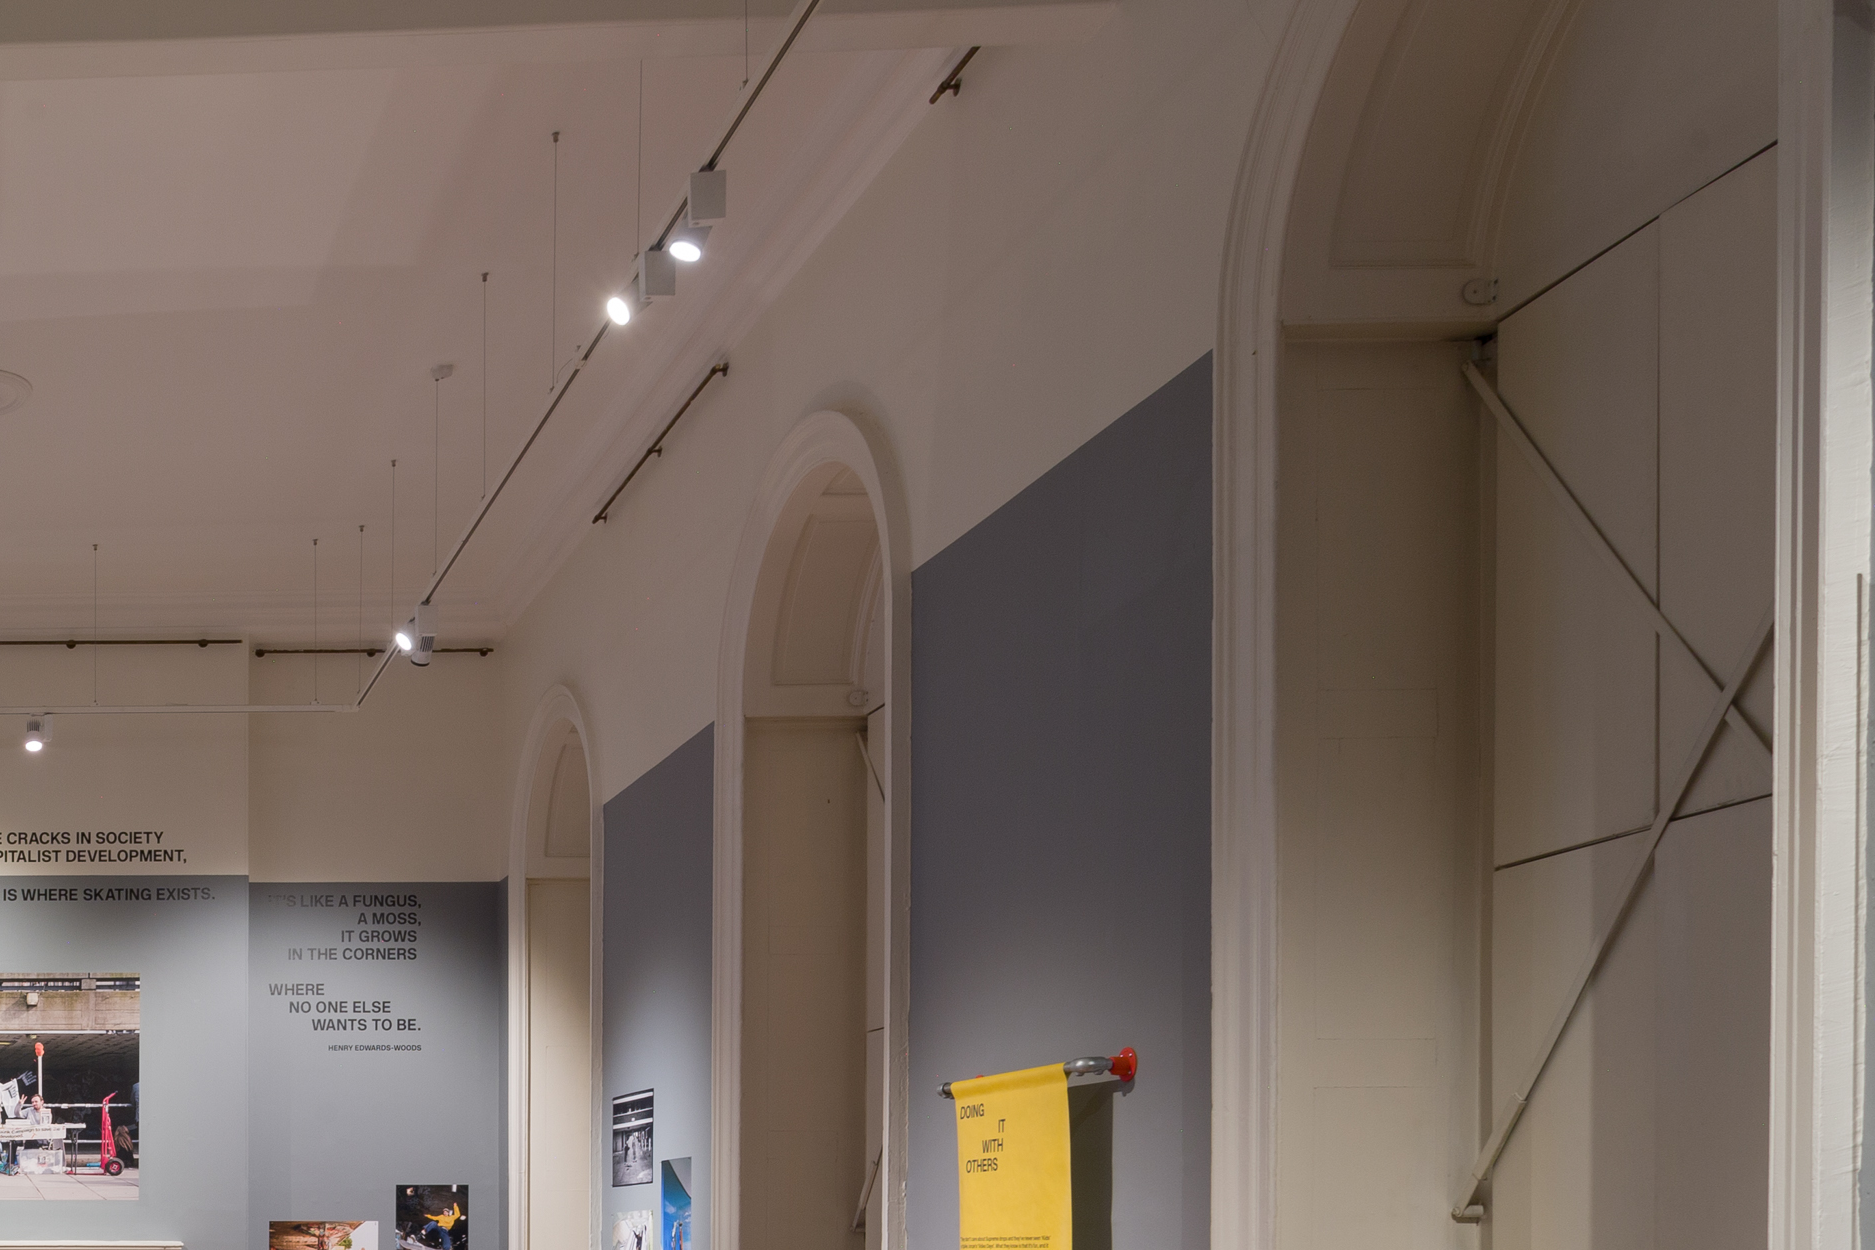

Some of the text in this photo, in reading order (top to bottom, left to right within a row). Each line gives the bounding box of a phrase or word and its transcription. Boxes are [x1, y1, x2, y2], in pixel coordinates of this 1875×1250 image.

[6, 831, 72, 845] CRACKS
[75, 832, 92, 845] IN
[95, 831, 165, 845] SOCIETY
[65, 848, 188, 865] DEVELOPMENT,
[3, 889, 18, 902] IS
[20, 888, 79, 902] WHERE
[82, 888, 152, 902] SKATING
[155, 887, 216, 901] EXISTS.
[300, 894, 334, 908] LIKE
[337, 894, 349, 908] A
[352, 894, 422, 909] FUNGUS,
[357, 912, 422, 926] A MOSS,
[341, 930, 417, 943] IT GROWS
[287, 947, 417, 961] IN THE CORNERS
[268, 983, 325, 996] WHERE
[289, 1000, 391, 1013] NO ONE ELSE
[311, 1018, 422, 1031] WANTS TO BE.
[959, 1103, 985, 1121] DOING
[997, 1118, 1006, 1134] IT
[981, 1137, 1004, 1154] WITH
[965, 1156, 998, 1174] OTHERS
